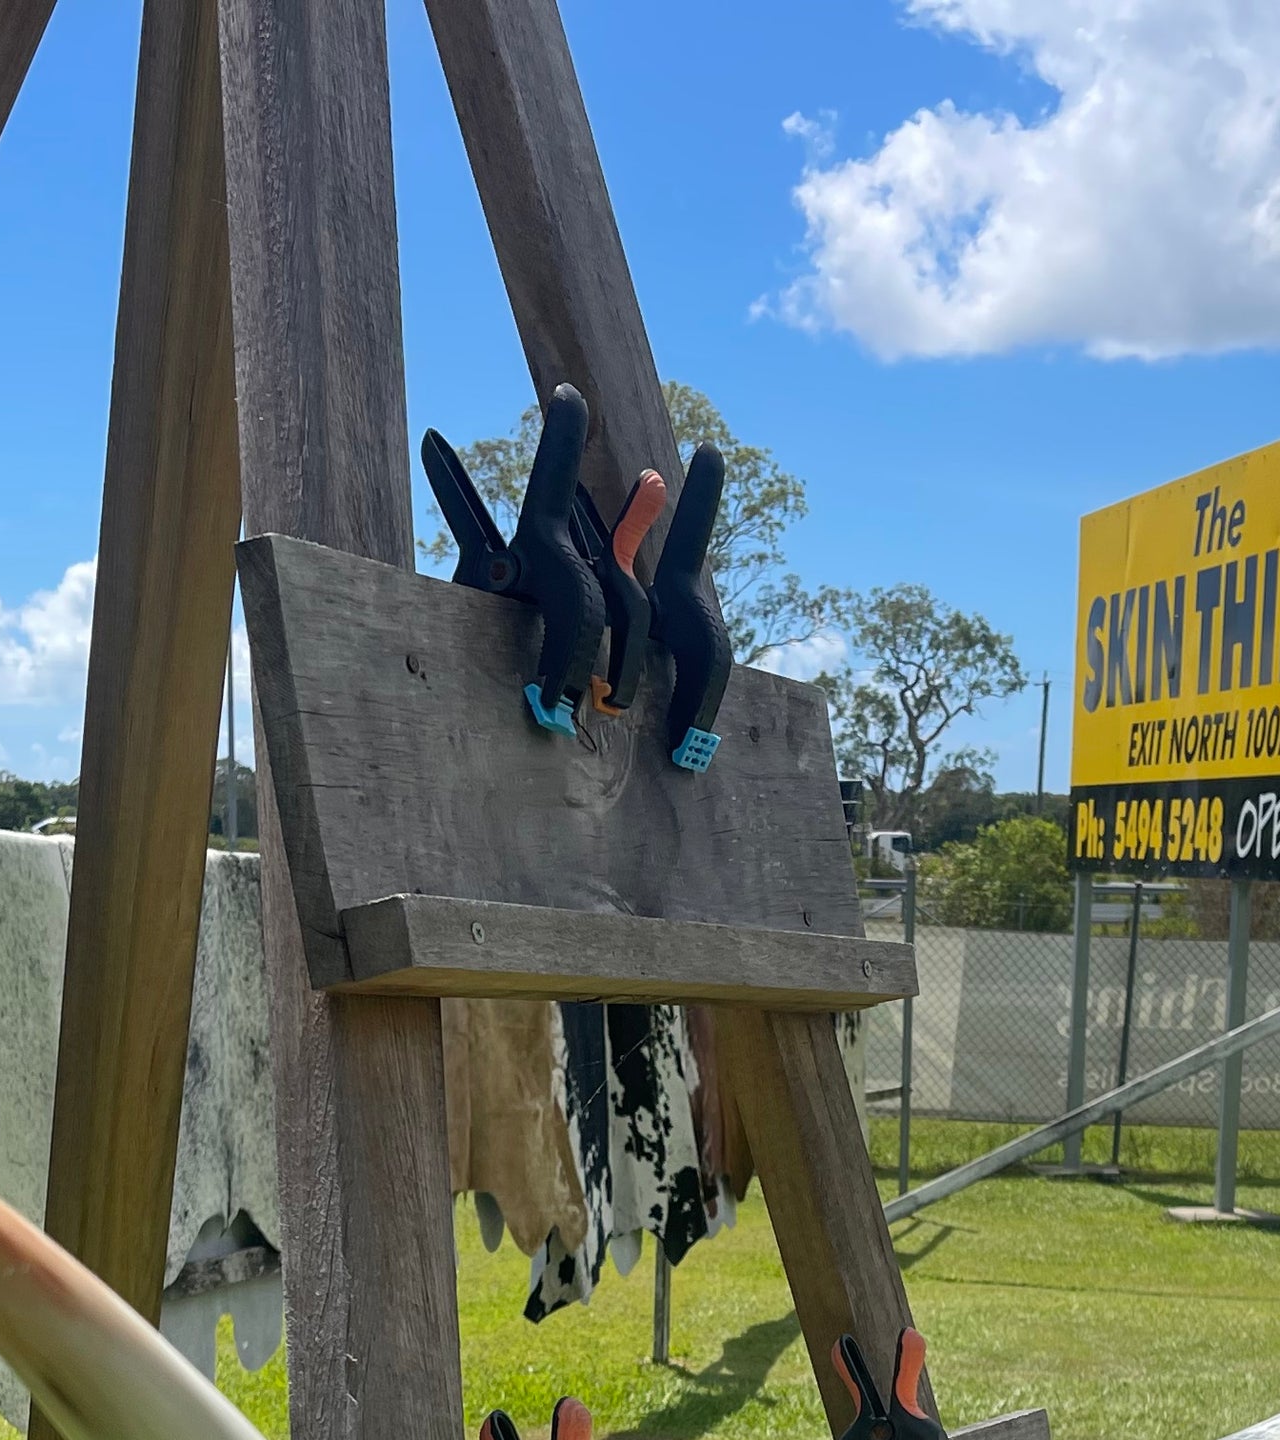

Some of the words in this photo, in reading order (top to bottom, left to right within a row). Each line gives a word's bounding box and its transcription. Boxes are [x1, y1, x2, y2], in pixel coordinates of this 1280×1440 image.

[1193, 486, 1246, 557] The
[1083, 575, 1186, 713] SKIN
[1128, 721, 1166, 767] EXIT
[1169, 710, 1240, 763] NORTH
[1075, 800, 1106, 859] Ph:
[1113, 799, 1163, 861] 5494
[1167, 796, 1224, 864] 5248
